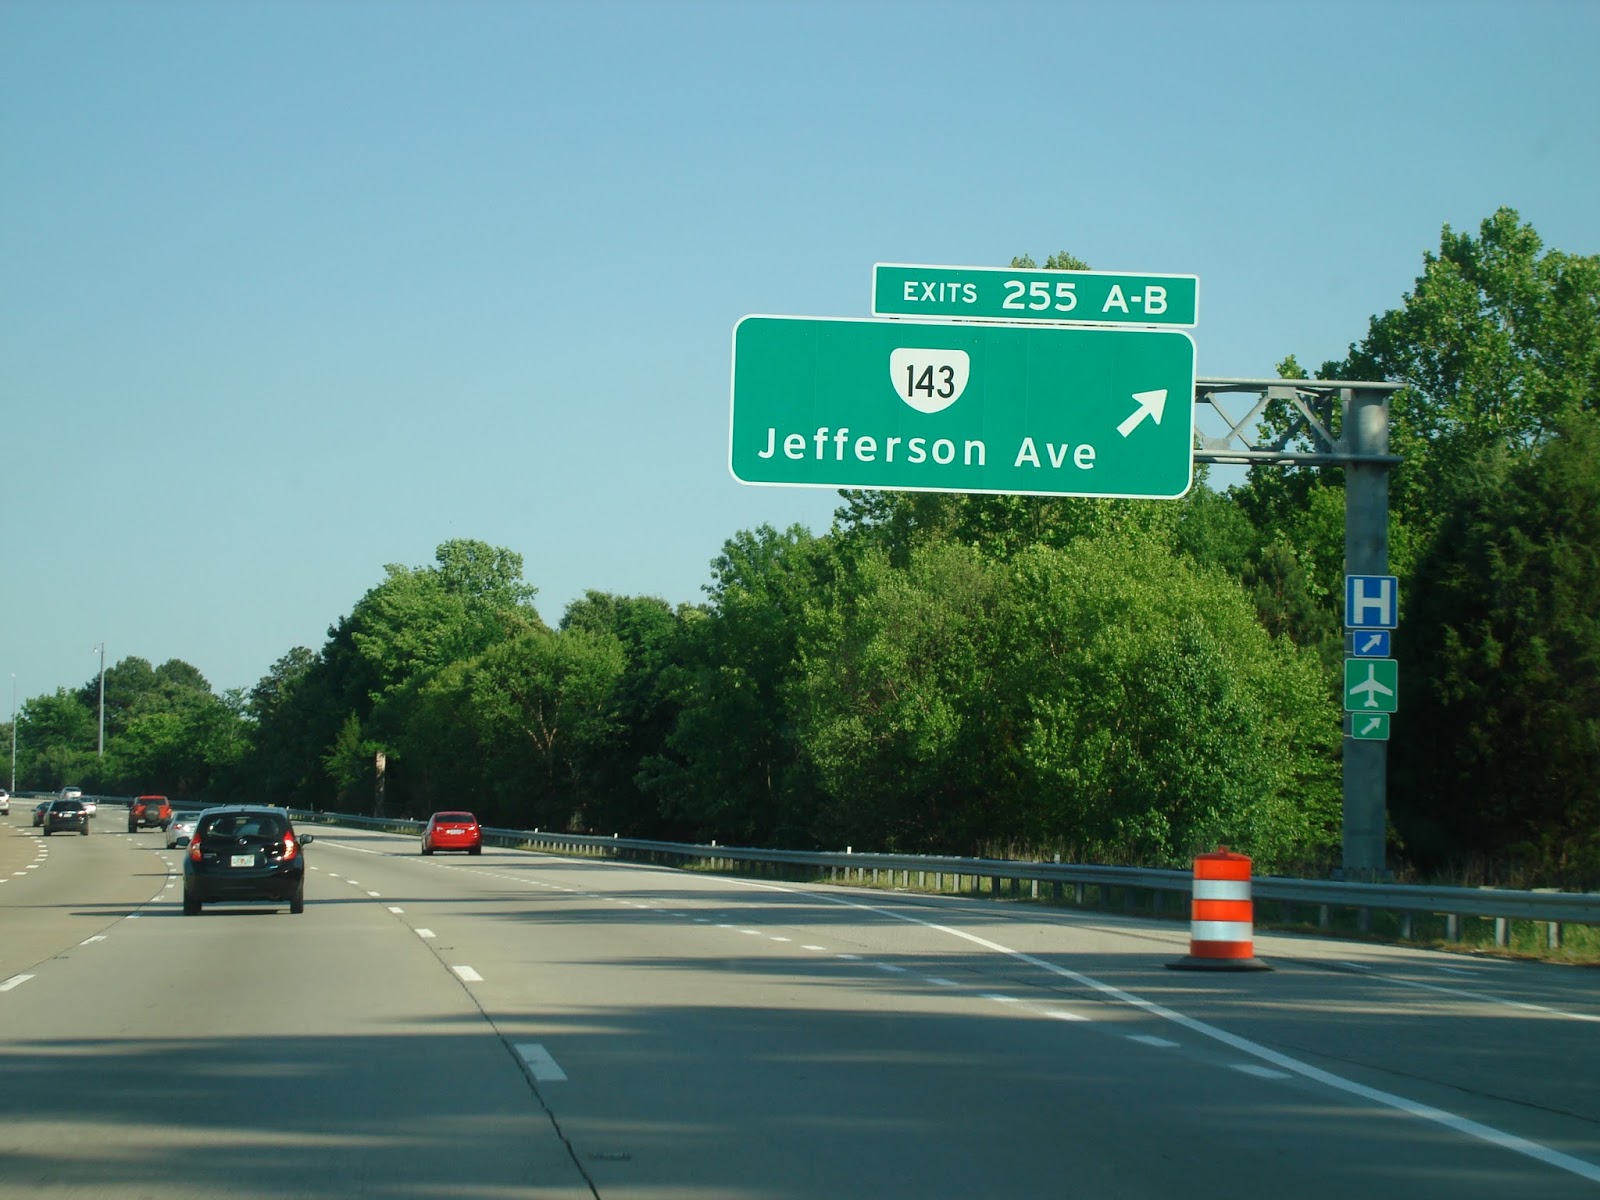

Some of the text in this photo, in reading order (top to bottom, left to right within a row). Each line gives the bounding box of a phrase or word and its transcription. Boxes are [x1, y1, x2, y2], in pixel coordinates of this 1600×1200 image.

[903, 280, 1168, 315] EXITS 255 A-B
[905, 364, 956, 399] 143
[757, 427, 1097, 470] Jefferson Ave
[1353, 578, 1391, 625] H
